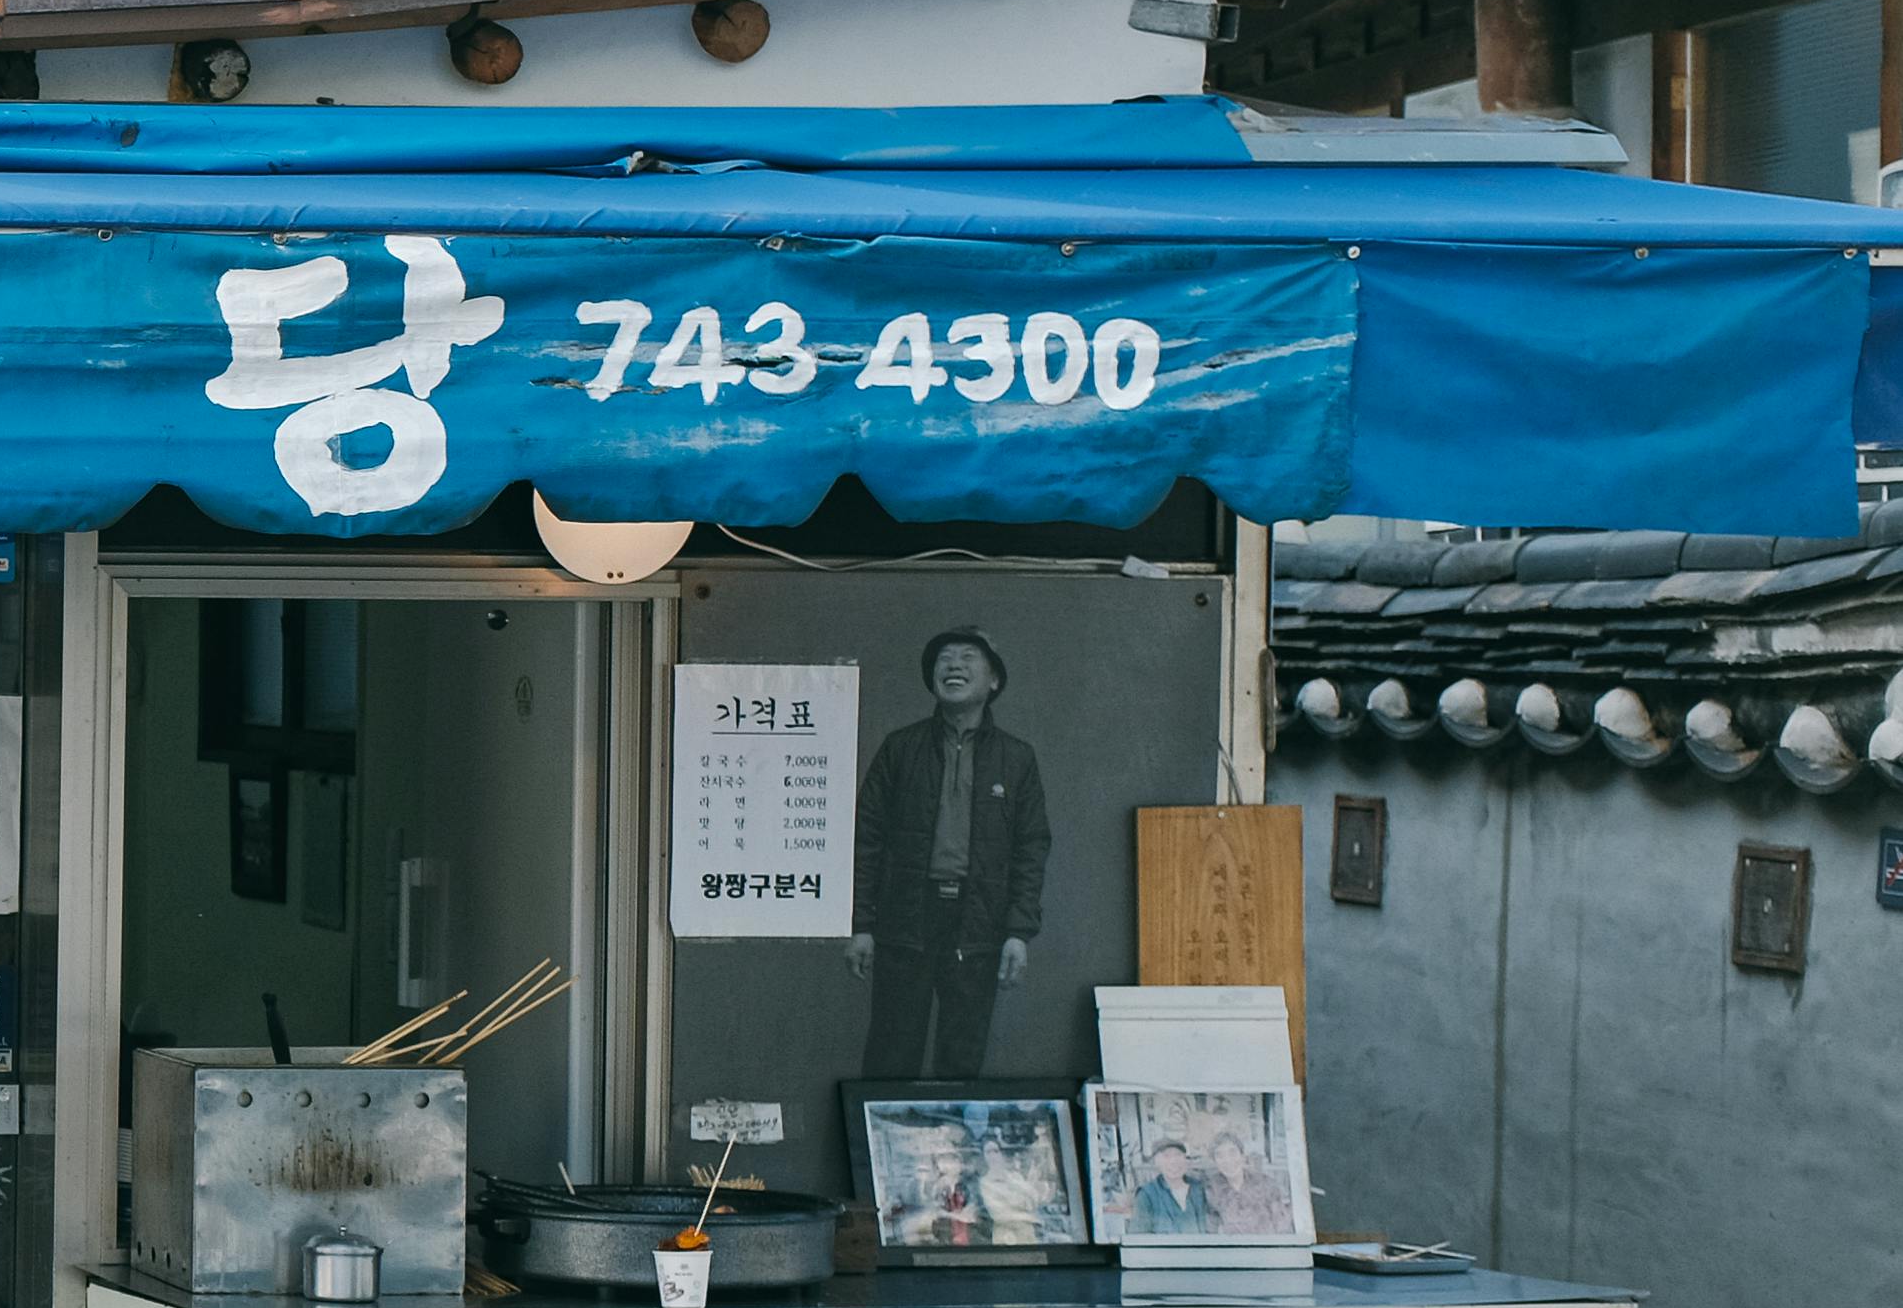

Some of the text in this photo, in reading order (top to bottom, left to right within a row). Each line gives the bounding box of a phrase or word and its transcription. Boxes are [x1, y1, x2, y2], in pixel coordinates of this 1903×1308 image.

[576, 299, 821, 404] 743
[855, 312, 1160, 411] 4300
[701, 873, 821, 899] 왕짱구분식
